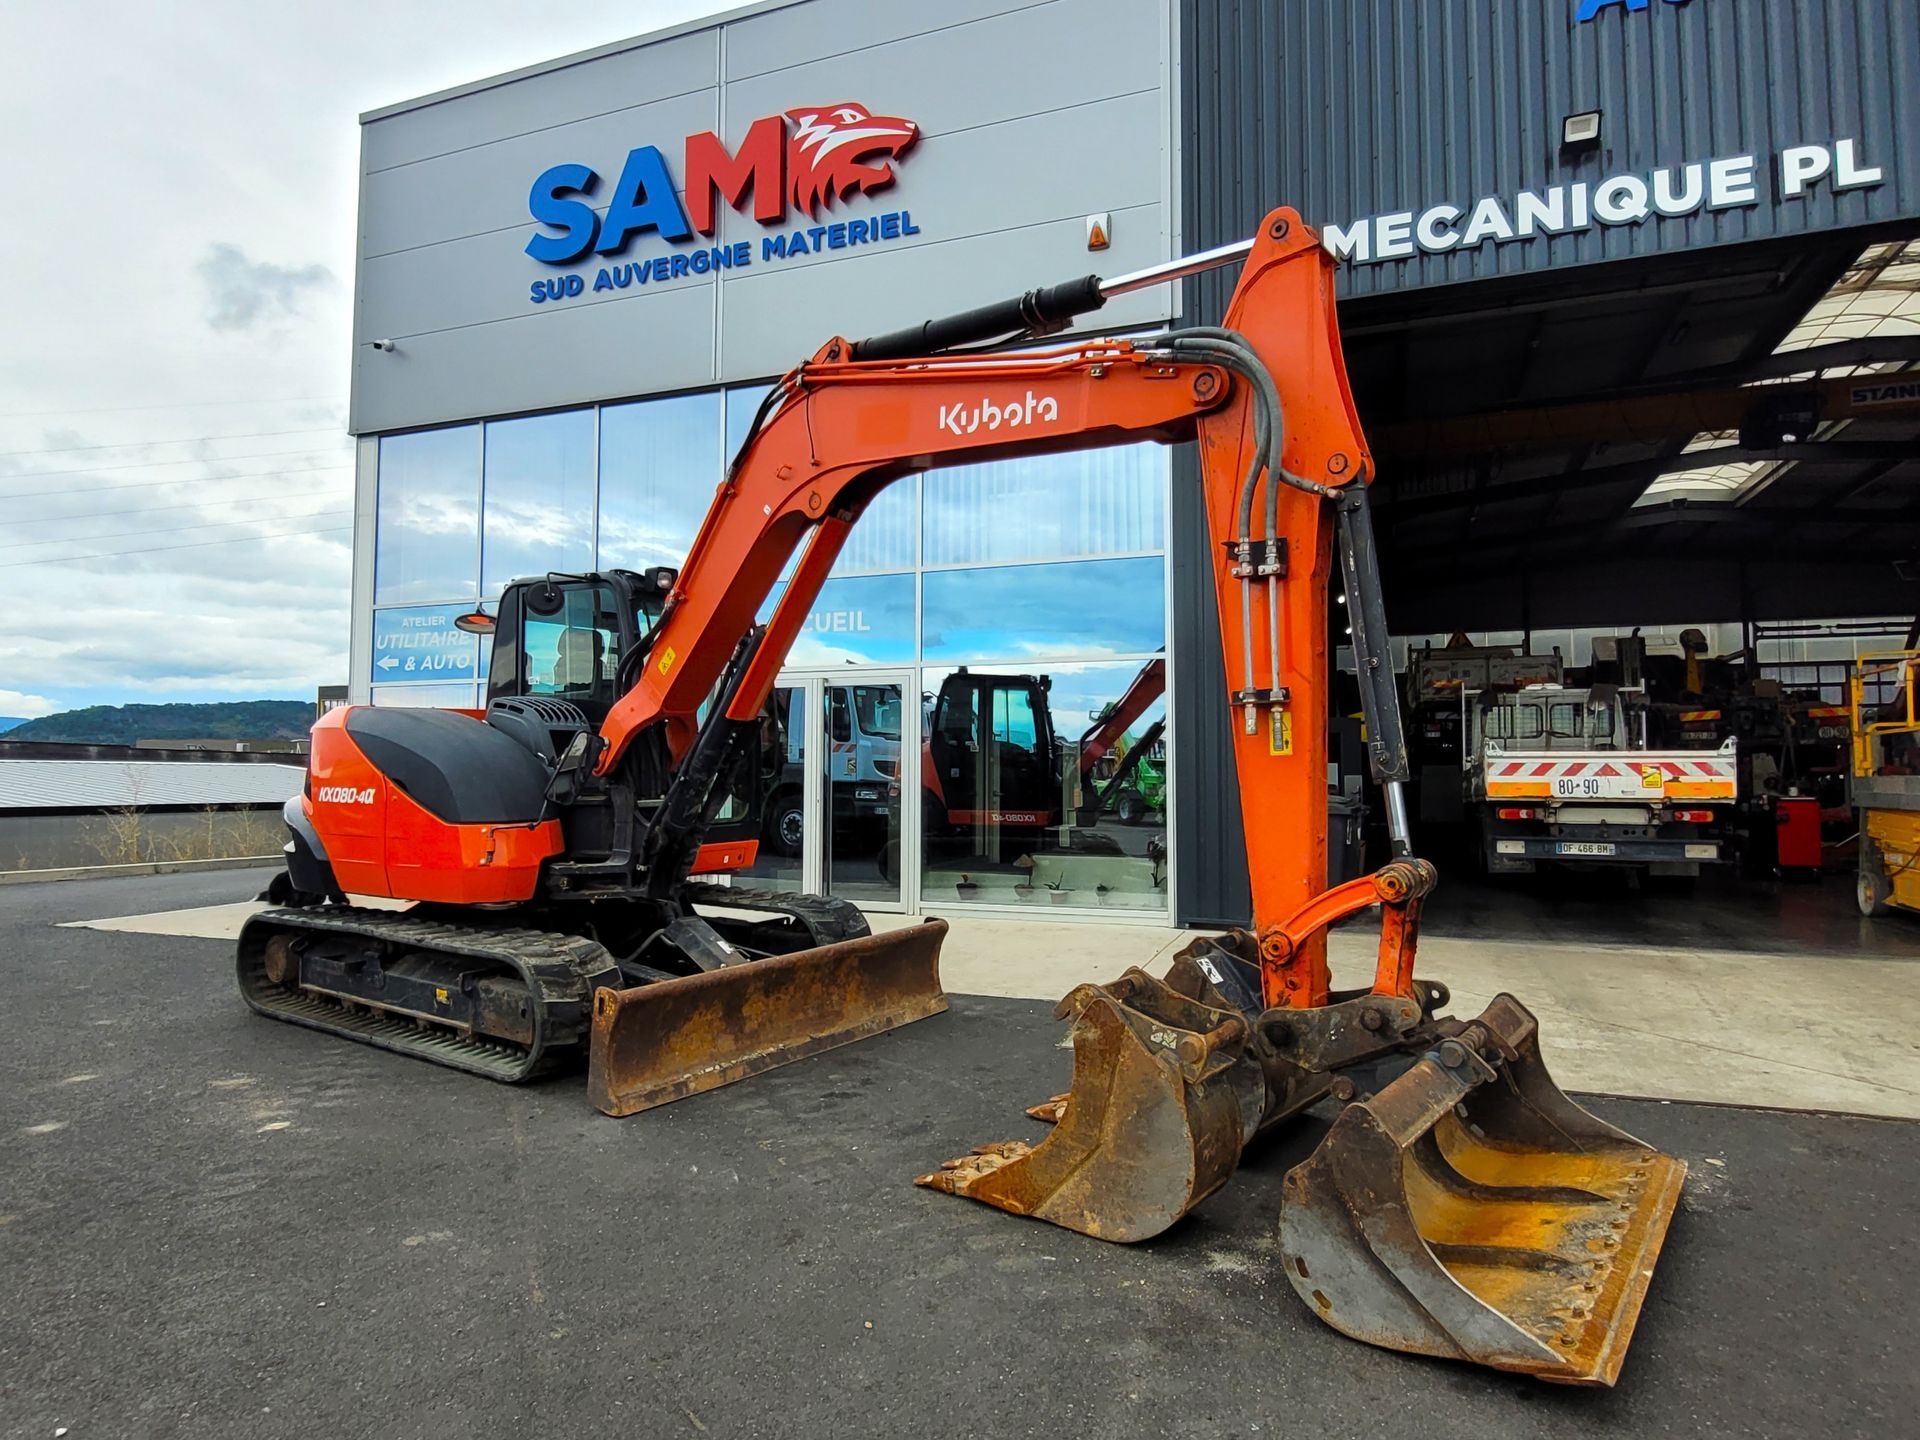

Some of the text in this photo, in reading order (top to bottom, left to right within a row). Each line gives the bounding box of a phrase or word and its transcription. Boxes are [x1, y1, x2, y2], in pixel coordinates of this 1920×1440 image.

[524, 115, 787, 264] SAM
[1322, 138, 1882, 263] MECANIQUE PL
[530, 211, 920, 303] SUD AUVERGNE MATERIEL
[939, 391, 1058, 435] Kubota
[1852, 383, 1920, 403] STAN
[401, 616, 446, 628] ATELIER
[404, 654, 470, 671] & AUTO
